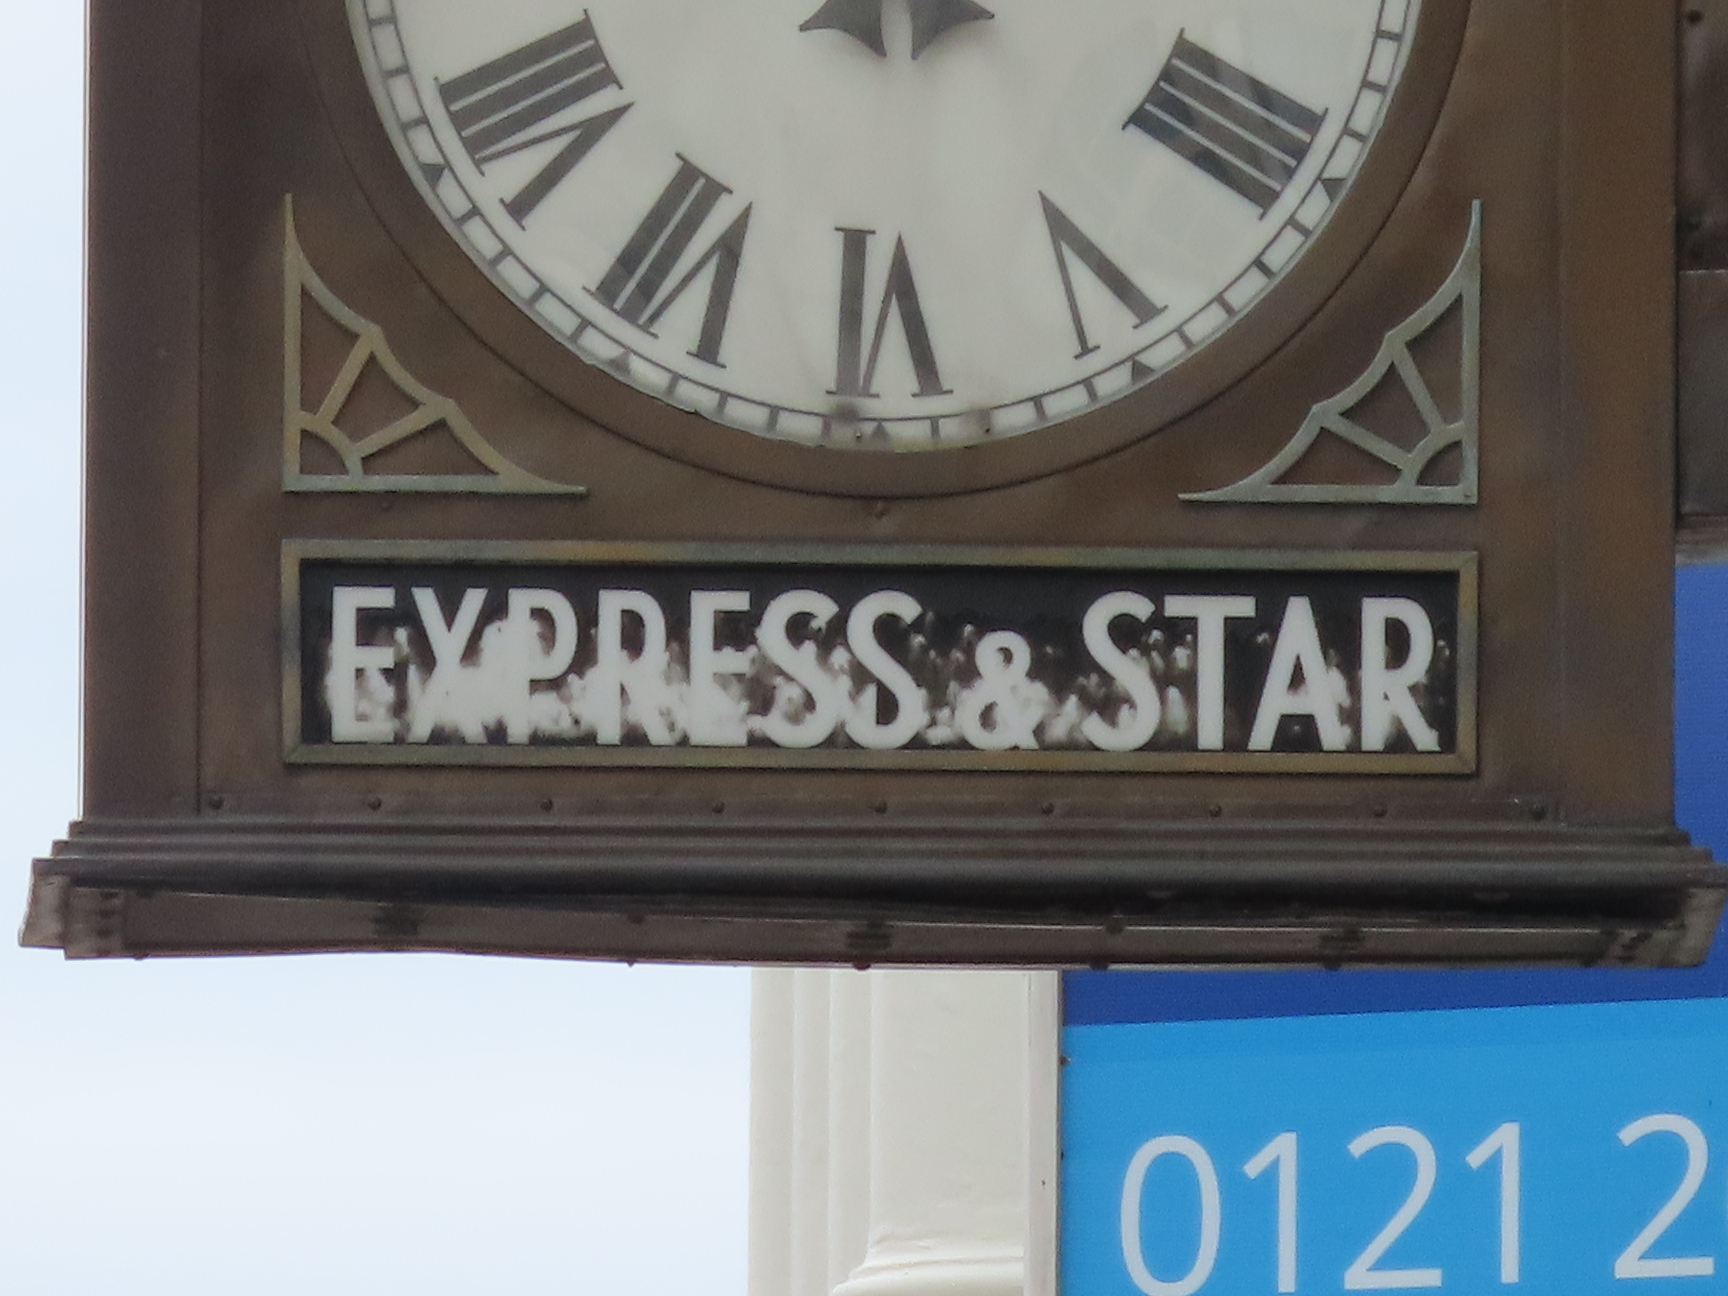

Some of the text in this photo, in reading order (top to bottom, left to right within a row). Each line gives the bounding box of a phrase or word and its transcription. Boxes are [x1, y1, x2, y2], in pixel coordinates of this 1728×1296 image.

[826, 226, 954, 400] VI
[1038, 190, 1168, 360] V
[330, 585, 1441, 752] EXPRESS & STAR
[1120, 1122, 1521, 1296] 0121
